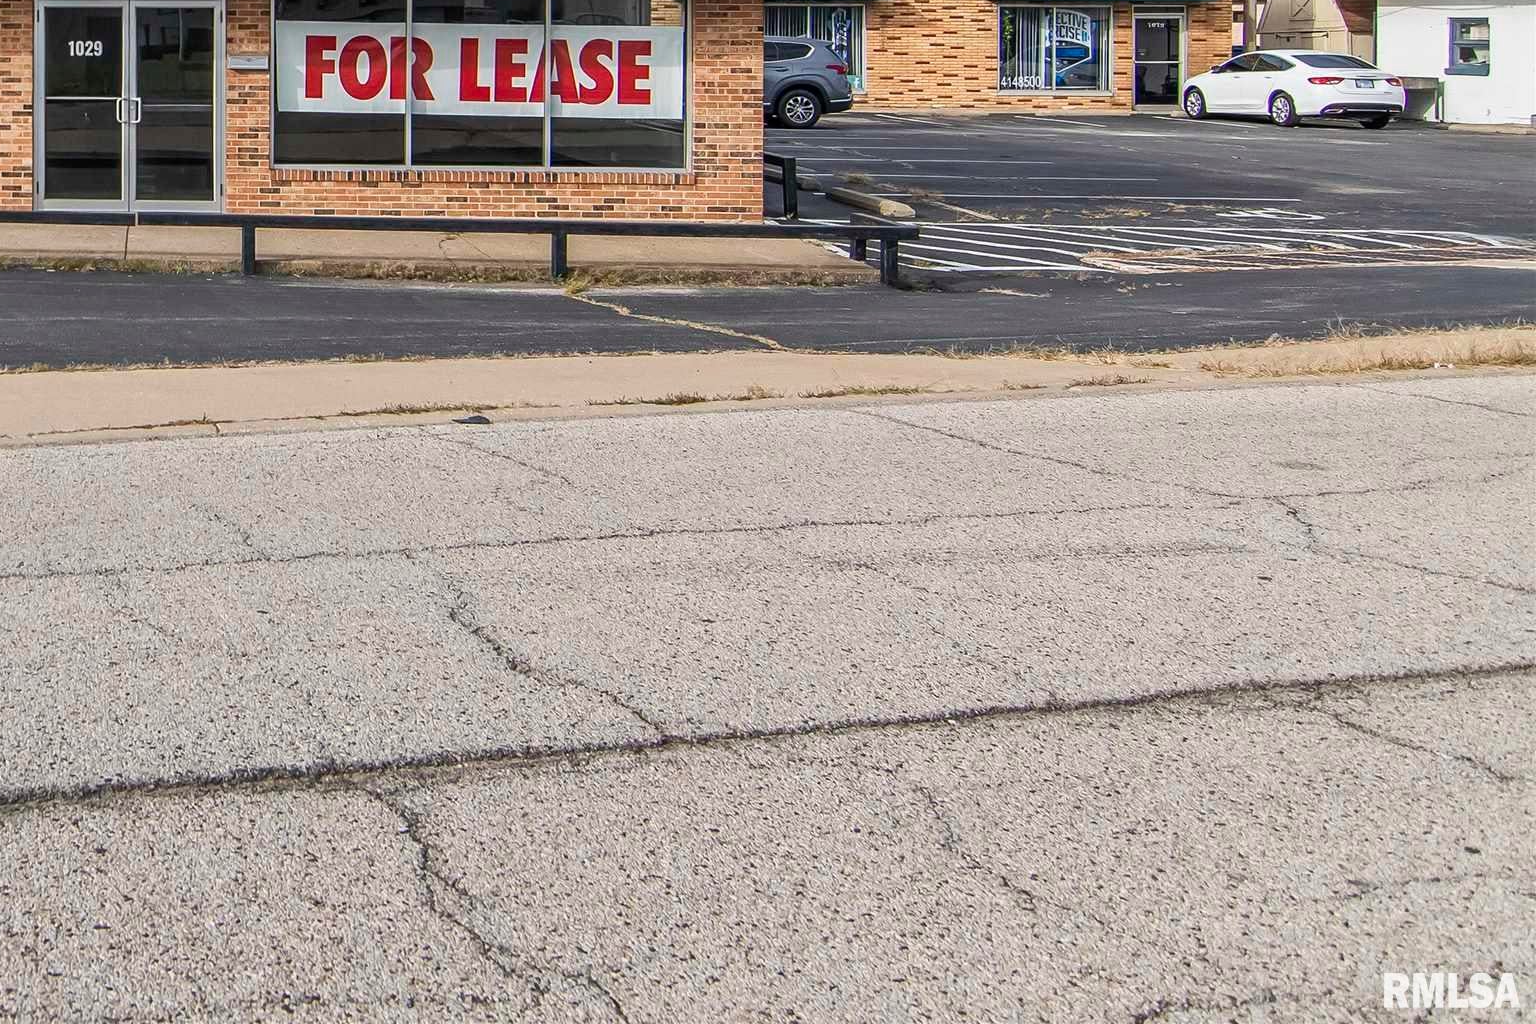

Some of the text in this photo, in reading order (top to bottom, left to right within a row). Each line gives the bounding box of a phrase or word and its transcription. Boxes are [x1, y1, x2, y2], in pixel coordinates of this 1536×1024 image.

[68, 40, 104, 57] 1029
[304, 34, 653, 106] FOR LEASE
